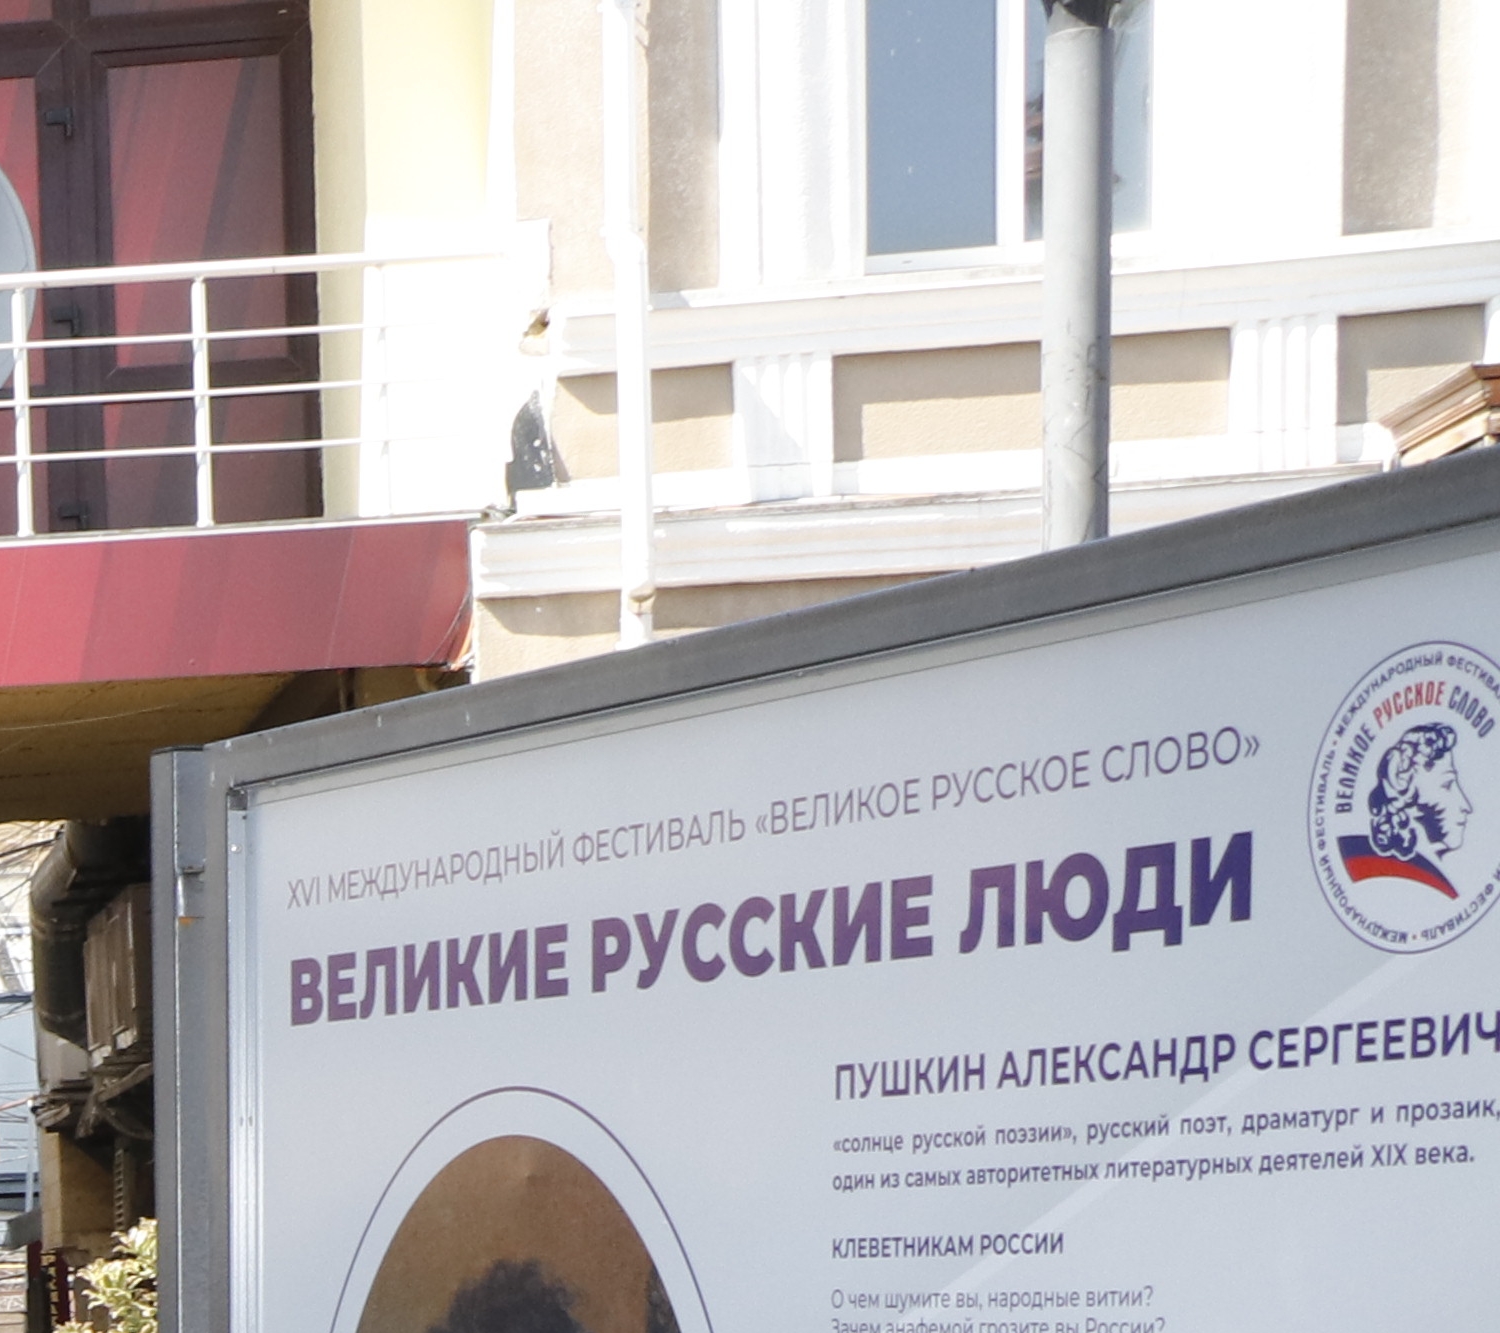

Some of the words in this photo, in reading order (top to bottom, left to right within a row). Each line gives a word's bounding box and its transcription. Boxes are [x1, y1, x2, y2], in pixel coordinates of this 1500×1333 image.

[1335, 651, 1443, 738] МЕЖДУНАРОДНЫЙ
[1335, 723, 1376, 815] ВЕЛИКОЕ
[1372, 681, 1446, 730] РУССКОЕ
[1448, 685, 1496, 739] СЛОВО
[287, 877, 320, 909] XVI
[328, 830, 564, 903] МЕЖДУНАРОДНЫЙ
[572, 809, 746, 866] ФЕСТИВАЛЬ
[755, 777, 921, 836] «ВЕЛИКОЕ
[931, 749, 1091, 811] РУССКОЕ
[1101, 725, 1261, 784] СЛОВО»
[289, 922, 570, 1028] ВЕЛИКИЕ
[590, 873, 935, 994] РУССКИЕ
[957, 829, 1254, 955] ЛЮДИ
[834, 1052, 987, 1101] ПУШКИН
[995, 1032, 1238, 1090] АЛЕКСАНДР
[1247, 1009, 1500, 1072] СЕРГЕЕВИЧ
[830, 1172, 876, 1194] один
[903, 1168, 962, 1189] самых
[964, 1162, 1100, 1189] авторитетных
[1102, 1154, 1254, 1183] литературных
[1256, 1142, 1365, 1176] деятелей
[1368, 1141, 1409, 1168] XIX
[1413, 1143, 1476, 1166] века.
[831, 1133, 905, 1154] «солнце
[910, 1123, 986, 1155] русской
[993, 1124, 1078, 1146] поэзии»,
[1085, 1112, 1170, 1146] русский
[1178, 1113, 1233, 1137] поэт,
[1239, 1105, 1361, 1137] драматург
[830, 1233, 975, 1260] КЛЕВЕТНИКАМ
[978, 1230, 1065, 1257] РОССИИ
[883, 1291, 951, 1315] шумите
[986, 1289, 1081, 1313] народные
[1084, 1283, 1154, 1308] витии?
